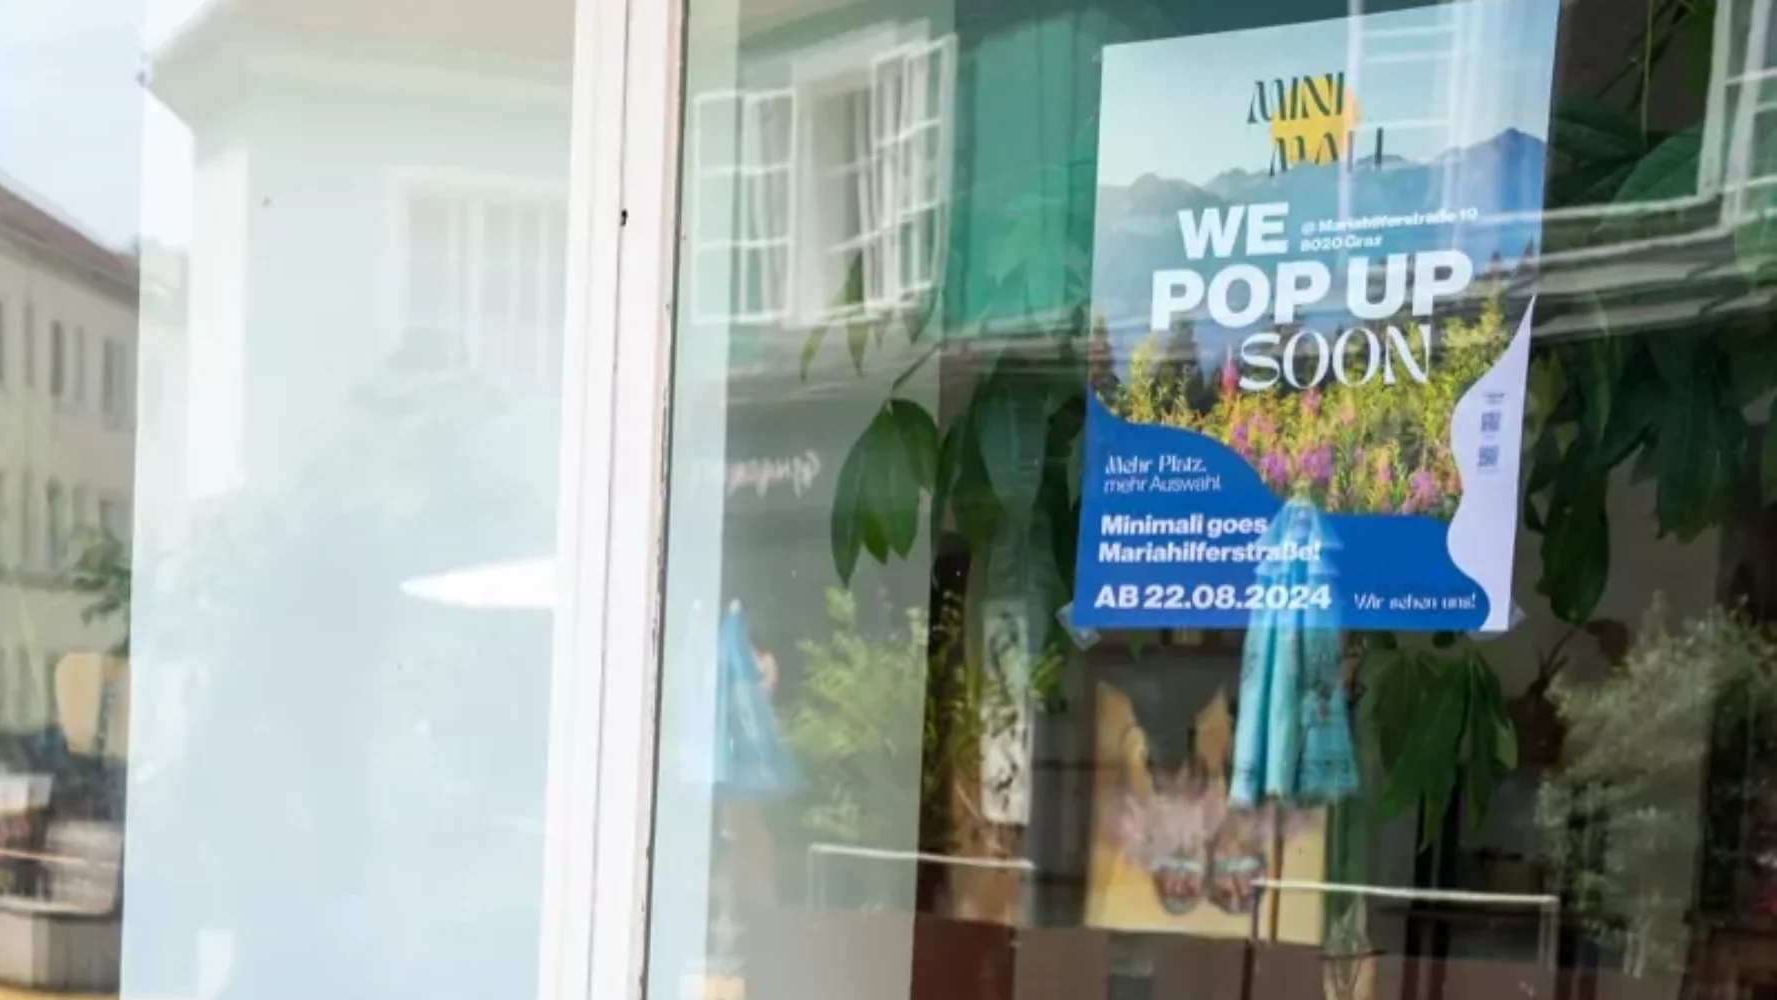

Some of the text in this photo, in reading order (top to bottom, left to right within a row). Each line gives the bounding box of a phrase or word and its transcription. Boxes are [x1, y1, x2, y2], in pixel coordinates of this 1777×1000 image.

[1247, 71, 1344, 124] MINI
[1177, 202, 1289, 259] WE
[1301, 235, 1383, 252] 8020 Graz
[1150, 250, 1472, 331] POP UP
[1238, 324, 1431, 391] SOON
[1105, 455, 1153, 475] Mehr
[1103, 477, 1145, 494] mehr
[1101, 513, 1269, 538] Minimali goes
[1098, 540, 1321, 563] Mariahilferstraße!
[1094, 583, 1332, 610] AB 22.08.2024
[1354, 593, 1384, 610] Wir
